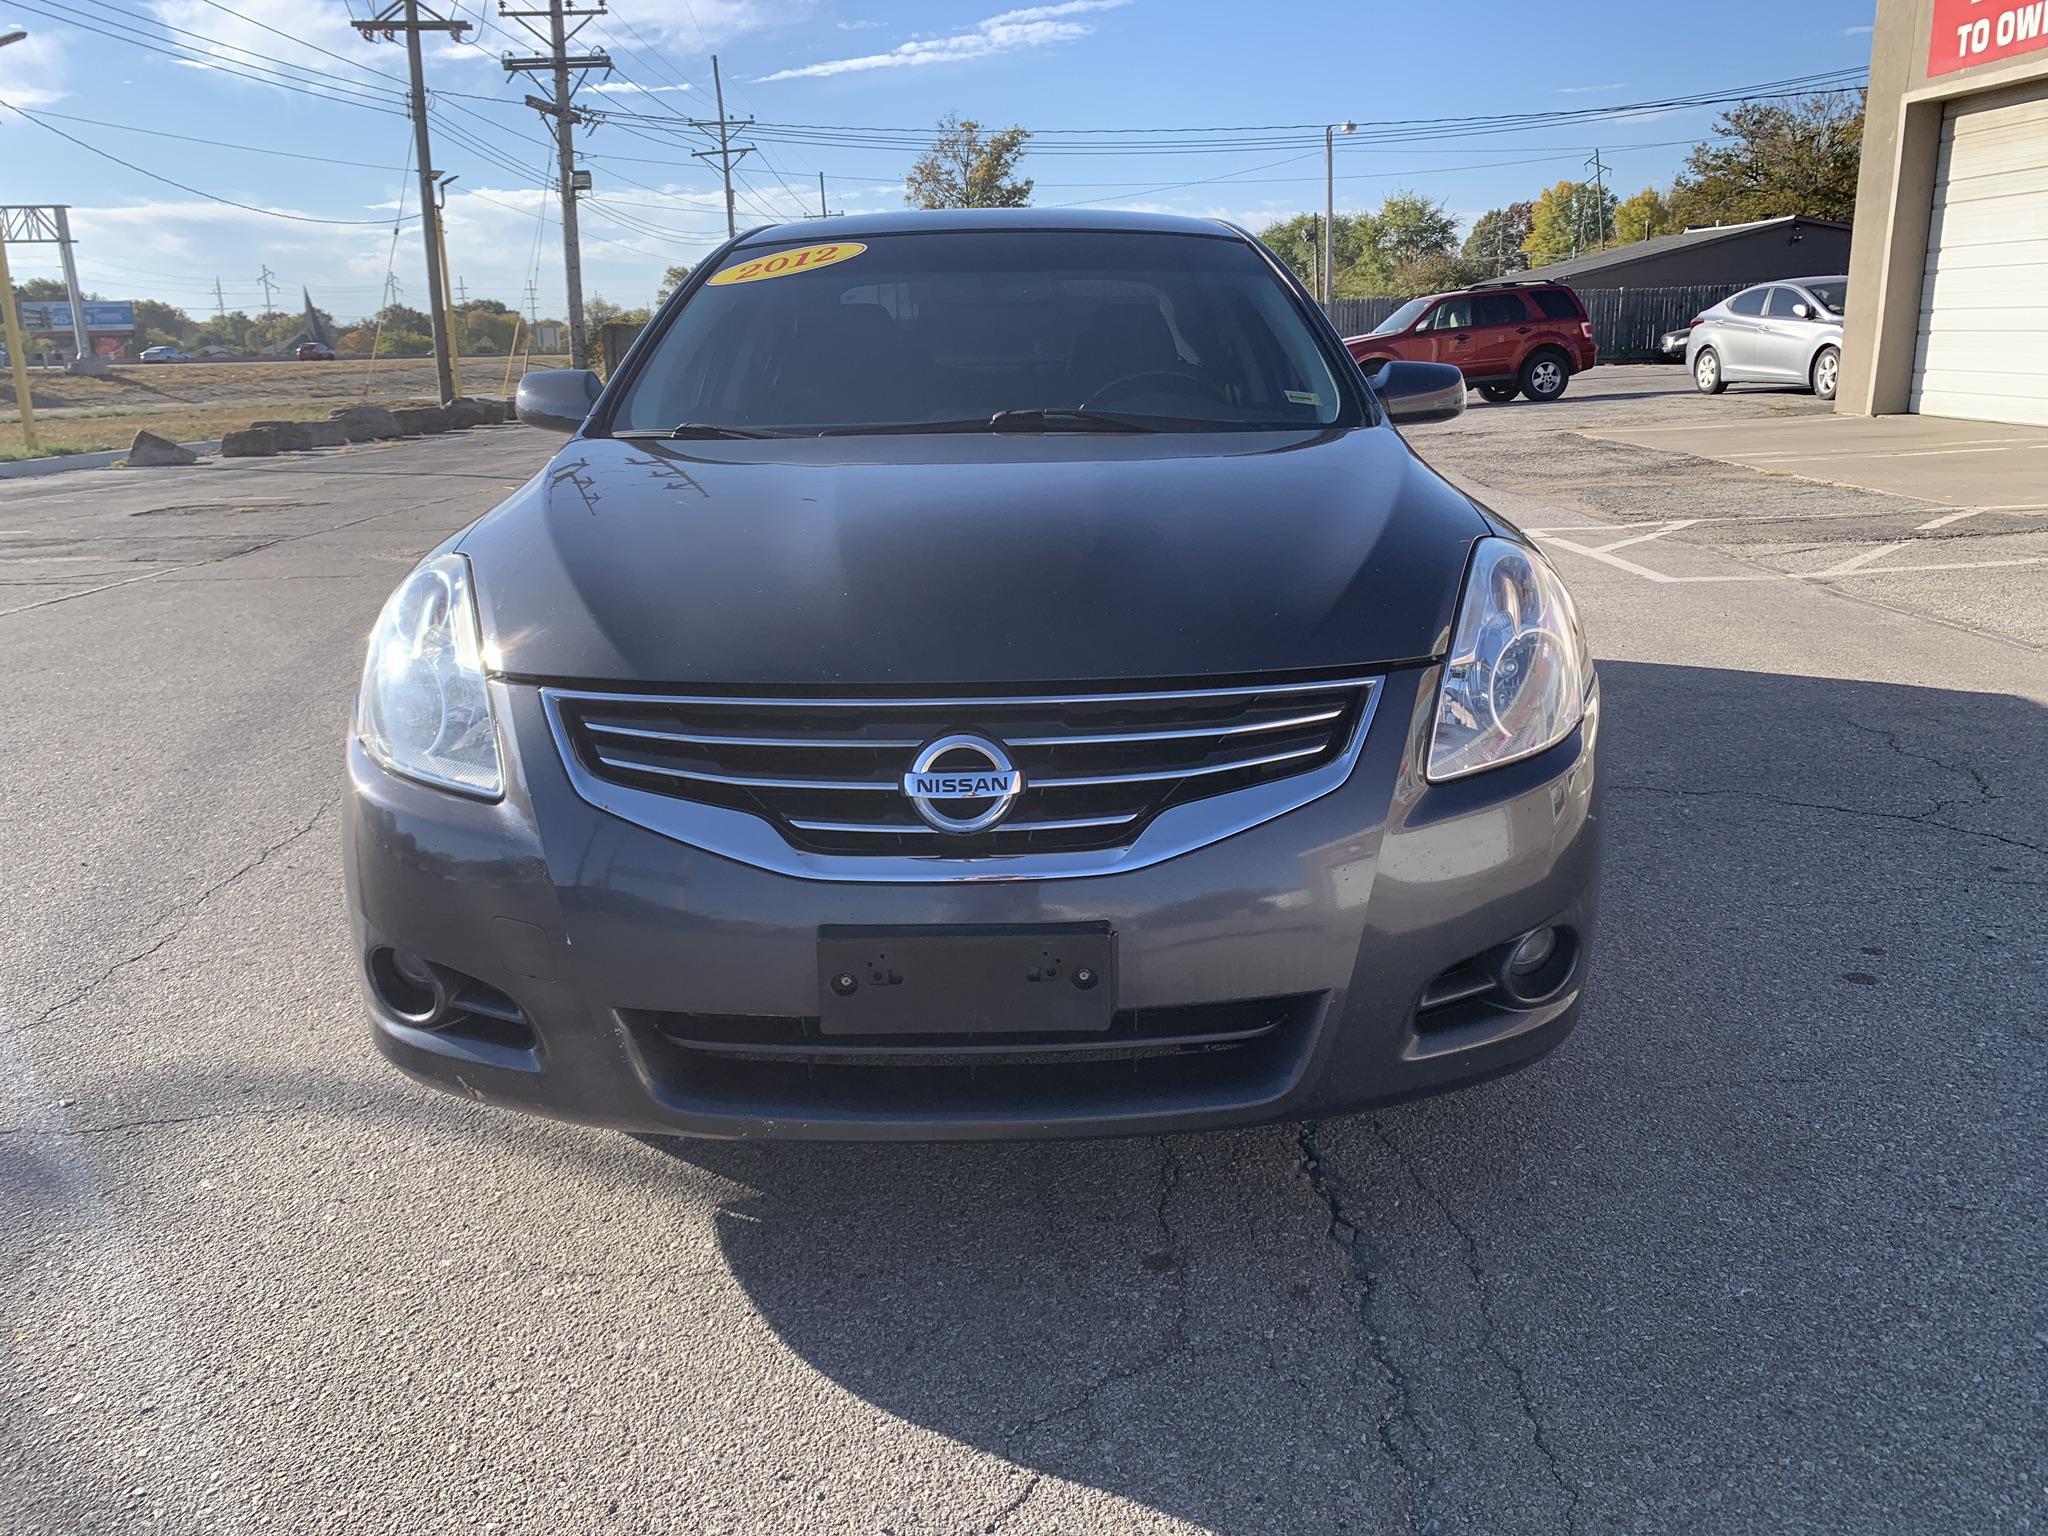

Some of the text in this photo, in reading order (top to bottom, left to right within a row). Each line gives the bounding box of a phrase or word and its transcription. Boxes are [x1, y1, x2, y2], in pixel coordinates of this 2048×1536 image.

[1957, 18, 1990, 58] TO
[735, 246, 839, 281] 2012
[916, 776, 1008, 793] NISSAN
